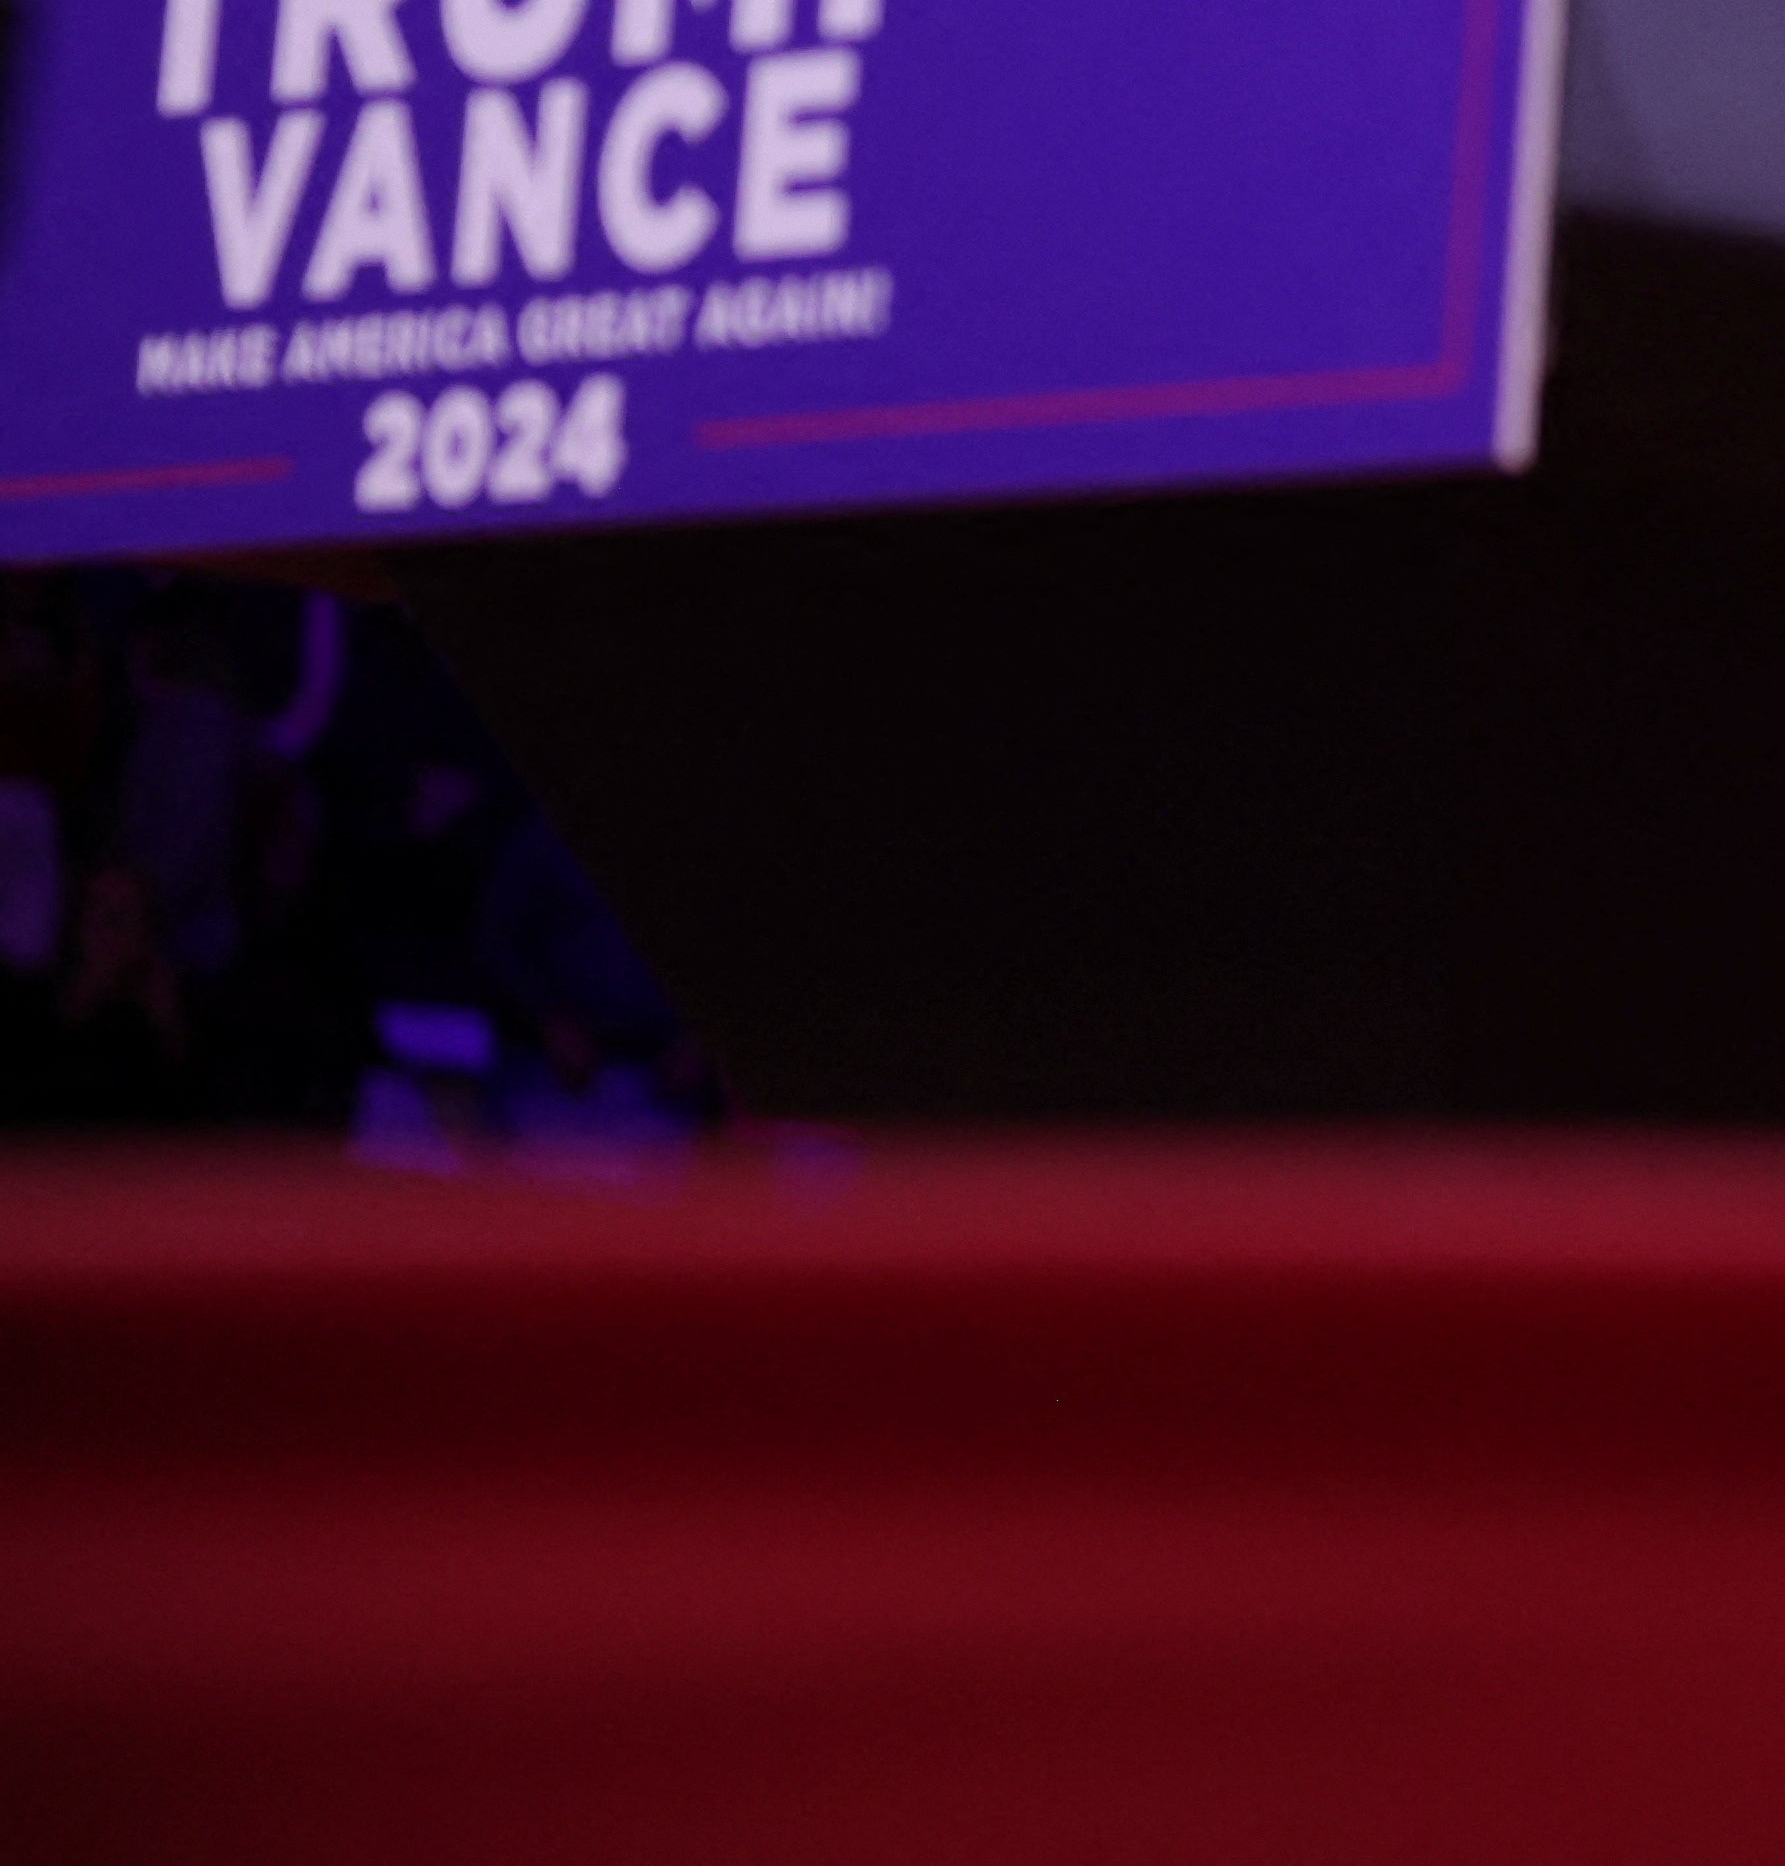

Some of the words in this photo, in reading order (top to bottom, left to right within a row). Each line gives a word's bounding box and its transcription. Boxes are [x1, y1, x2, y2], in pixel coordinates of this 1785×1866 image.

[200, 46, 863, 309] VANCE
[137, 323, 277, 397] MAKE
[282, 301, 510, 384] AMERICA
[515, 283, 693, 366] GREAT
[695, 264, 893, 351] AGAIN!
[353, 371, 629, 514] 2024
